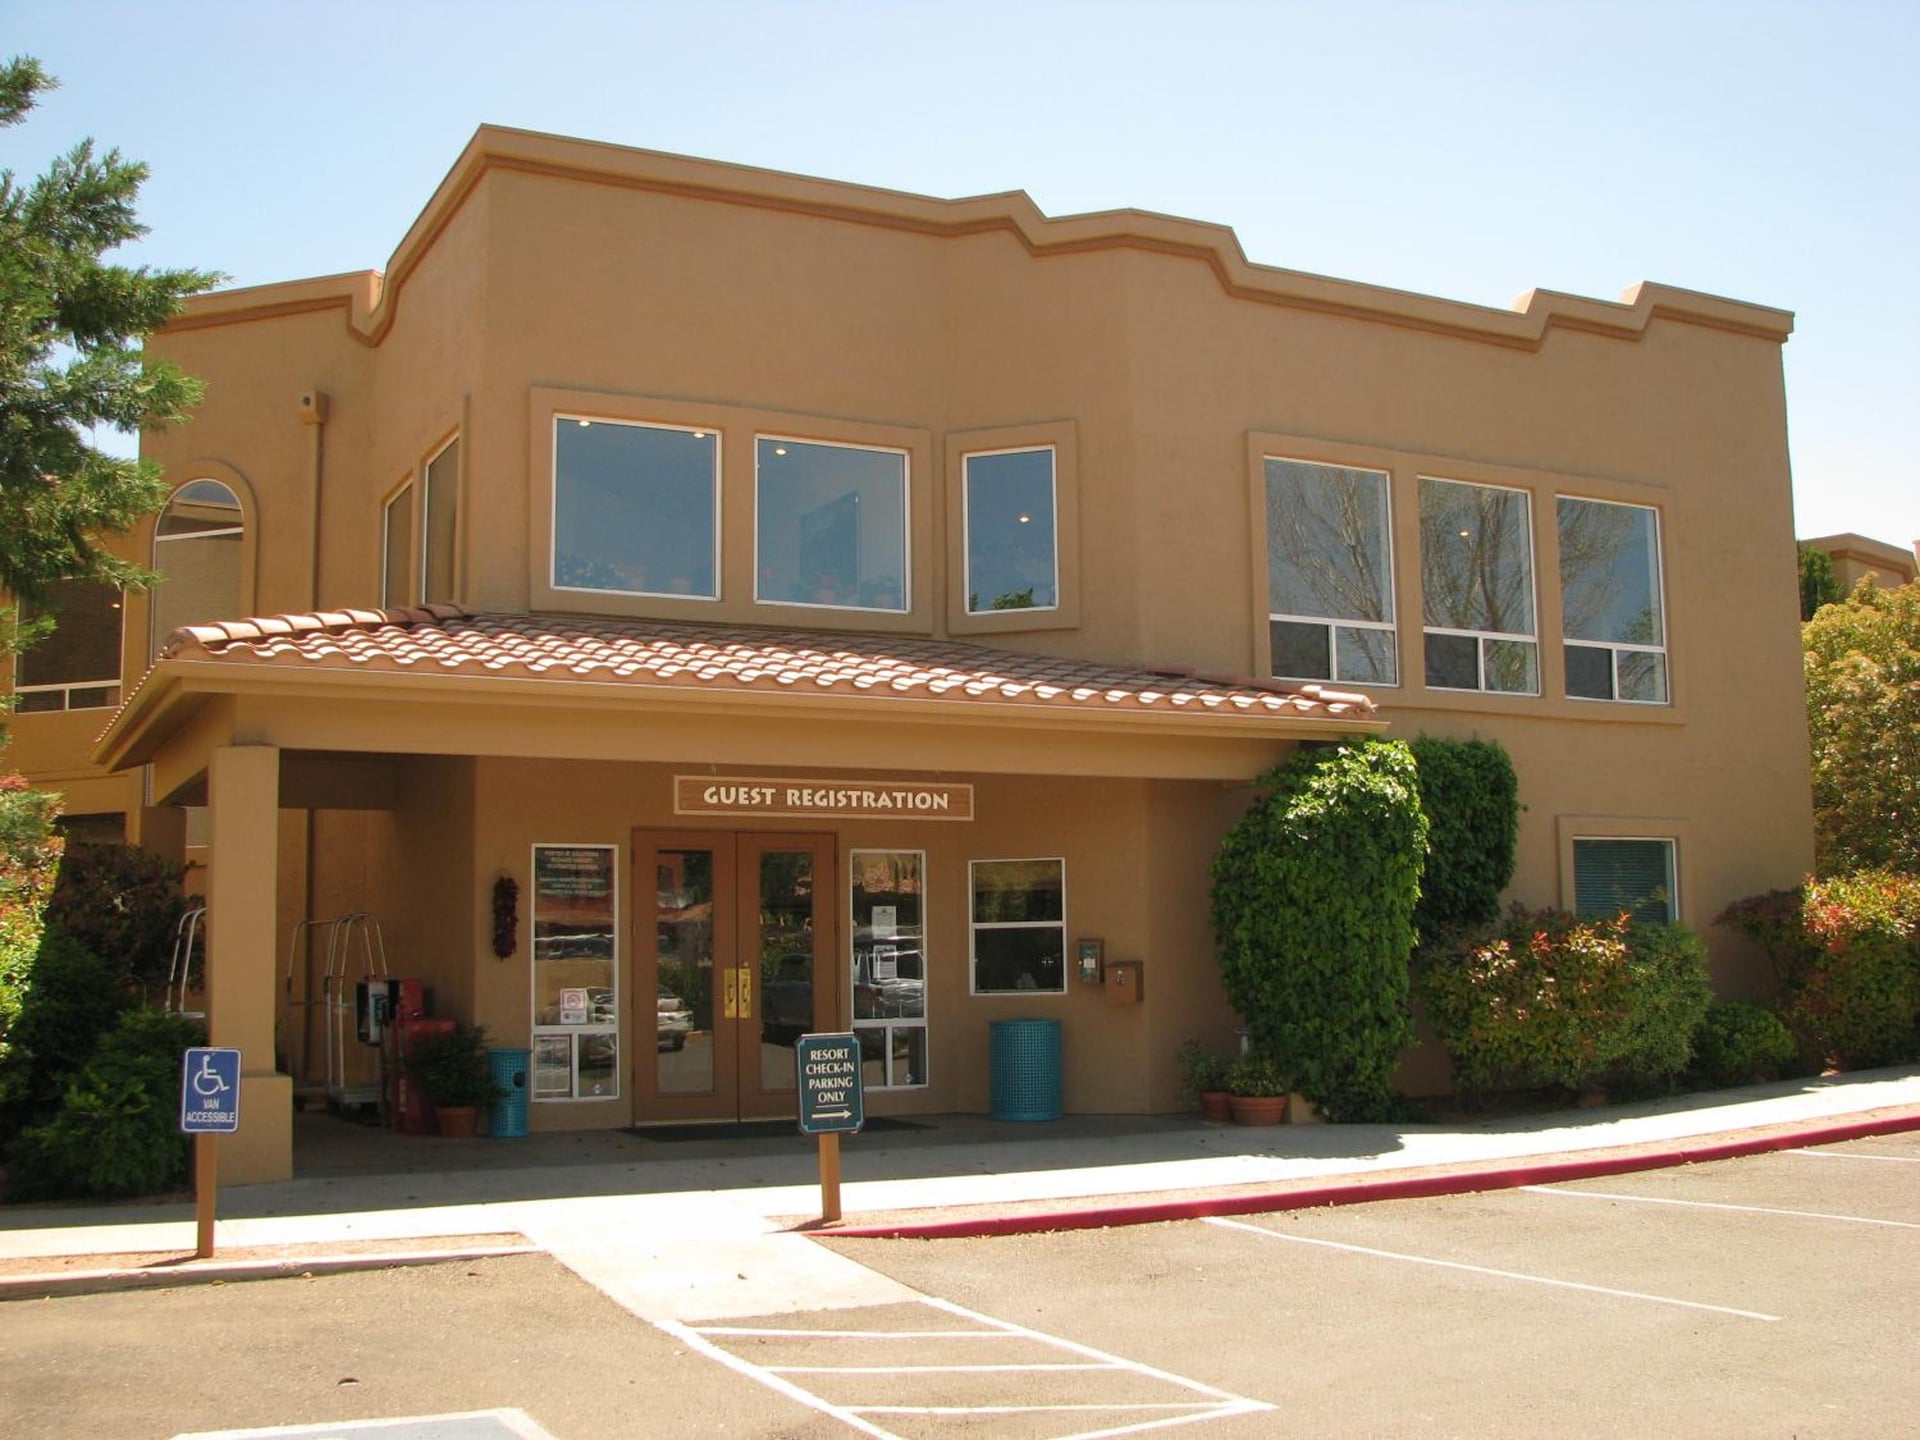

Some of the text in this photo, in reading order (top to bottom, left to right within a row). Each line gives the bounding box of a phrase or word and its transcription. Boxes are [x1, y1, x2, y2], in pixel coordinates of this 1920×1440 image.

[703, 786, 949, 810] GUEST REGISTRATION
[810, 1048, 849, 1061] RESORT
[805, 1062, 854, 1075] CHECK-IN
[808, 1076, 853, 1089] PARKING
[817, 1091, 846, 1103] ONLY
[203, 1098, 220, 1110] VAN
[186, 1111, 235, 1123] ACCESSIBLE
